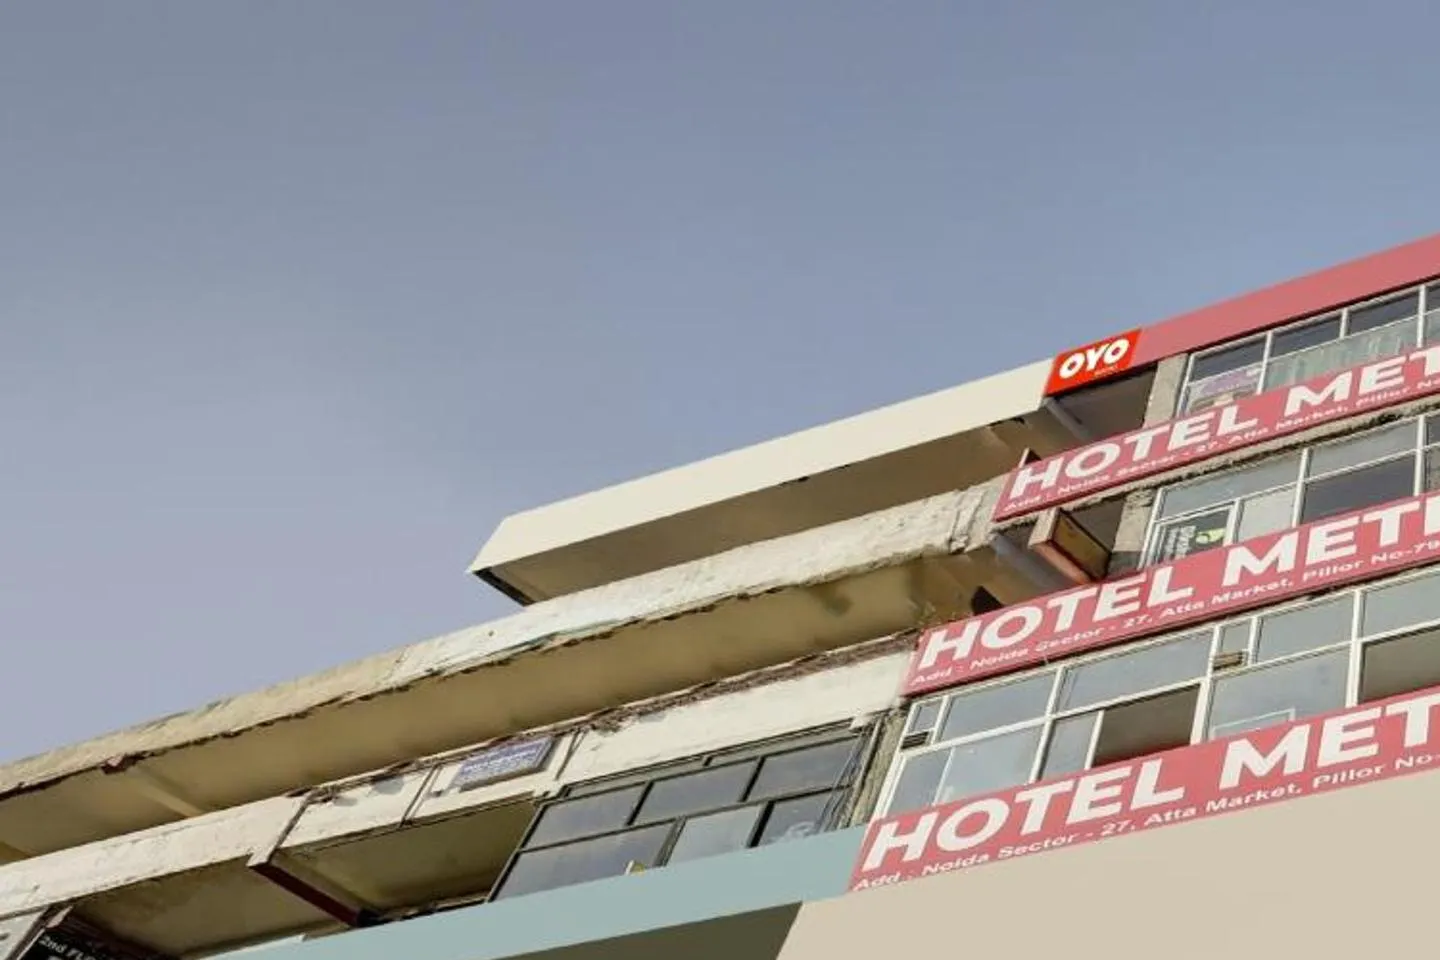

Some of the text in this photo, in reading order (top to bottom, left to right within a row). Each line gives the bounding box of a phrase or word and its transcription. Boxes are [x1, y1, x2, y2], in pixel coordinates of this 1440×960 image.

[1059, 338, 1130, 379] OYO
[1010, 405, 1259, 499] HOTEL
[919, 565, 1193, 669] HOTEL
[912, 665, 952, 686] Add
[970, 645, 1029, 671] Noida
[854, 871, 901, 891] Add
[921, 851, 989, 876] Noida
[997, 832, 1077, 860] Sector
[1143, 804, 1196, 827] Atta
[862, 759, 1184, 872] HOTEL
[39, 935, 68, 953] 2nd
